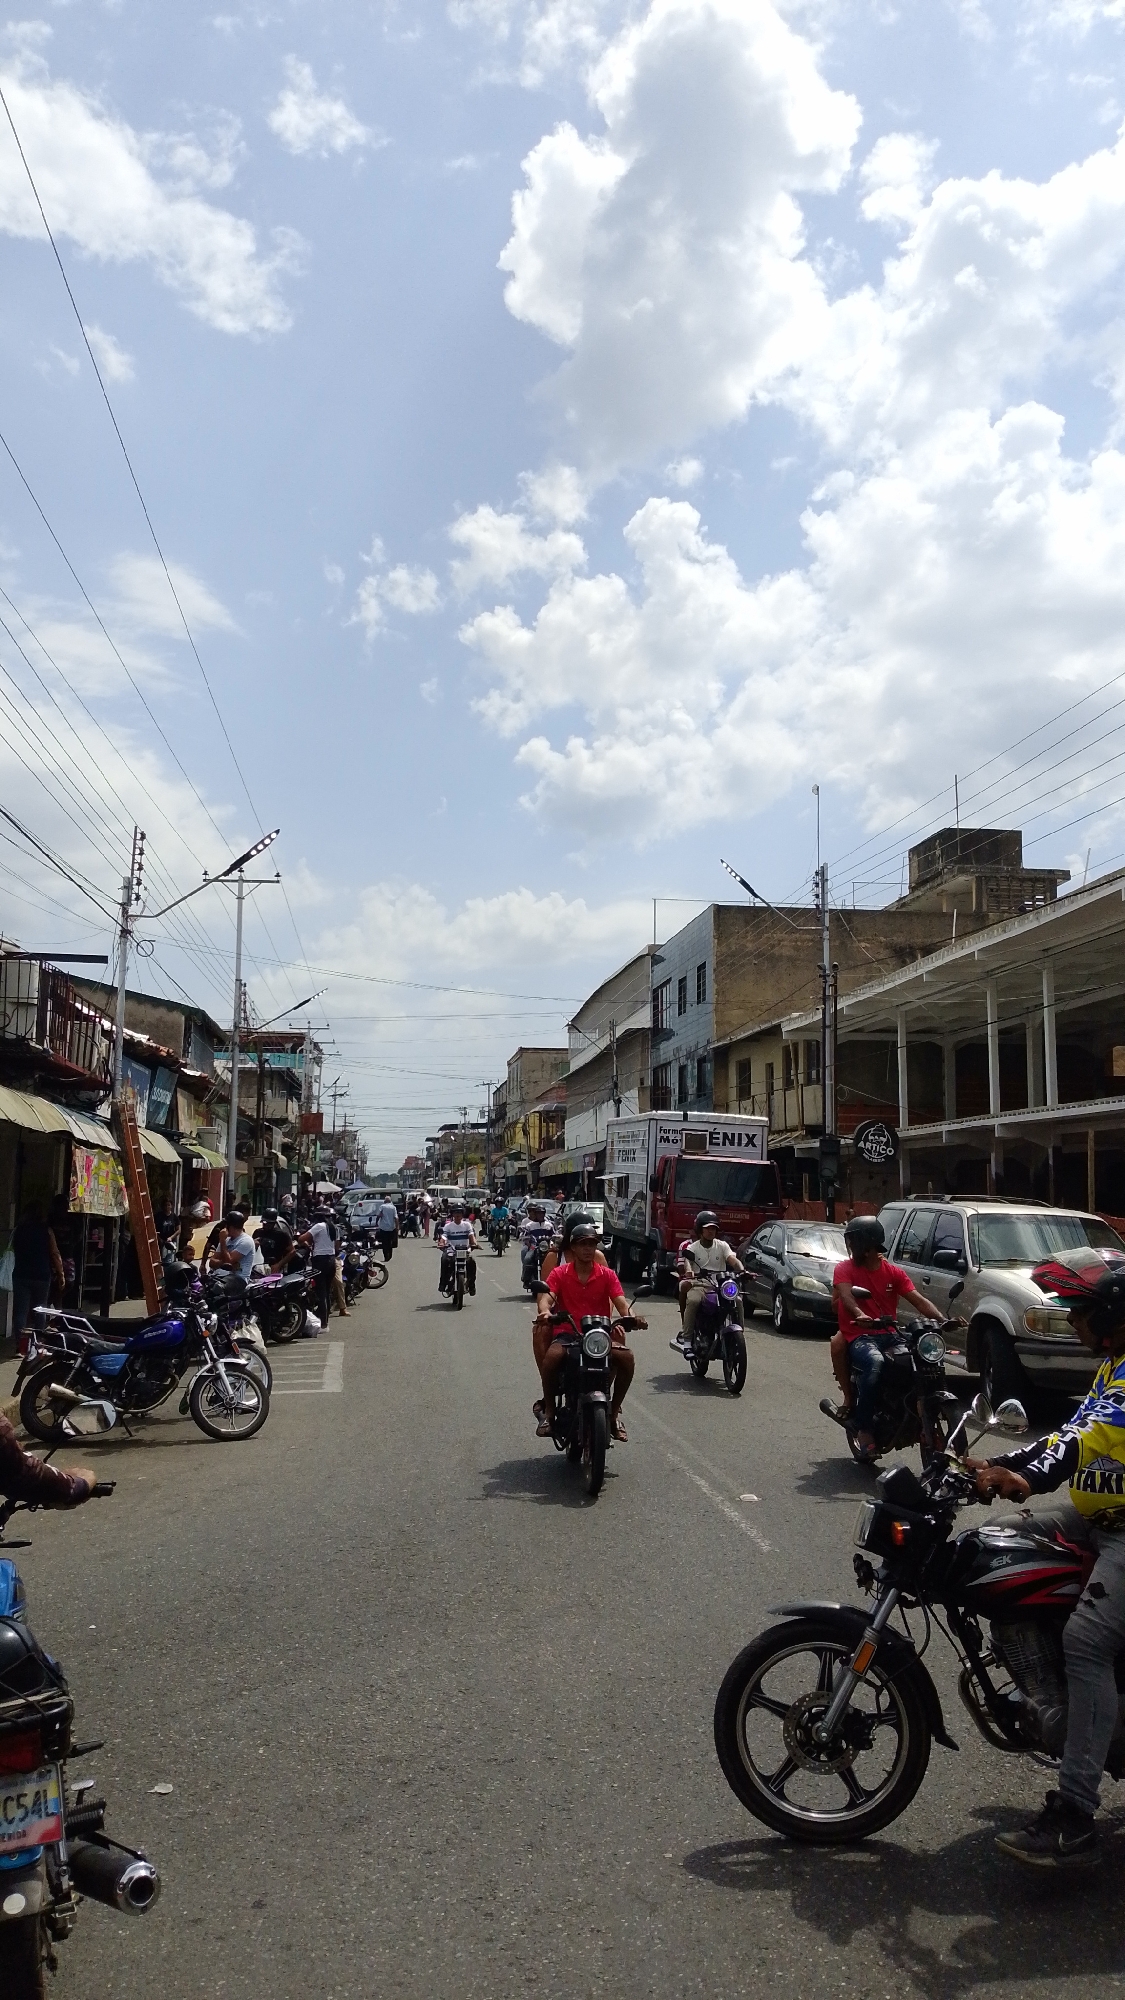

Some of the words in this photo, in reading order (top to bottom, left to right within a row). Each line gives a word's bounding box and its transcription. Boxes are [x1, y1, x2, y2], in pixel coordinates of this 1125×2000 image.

[708, 1128, 758, 1148] ÉNIX
[857, 1140, 895, 1156] ARTICO
[0, 1789, 58, 1826] C54L
